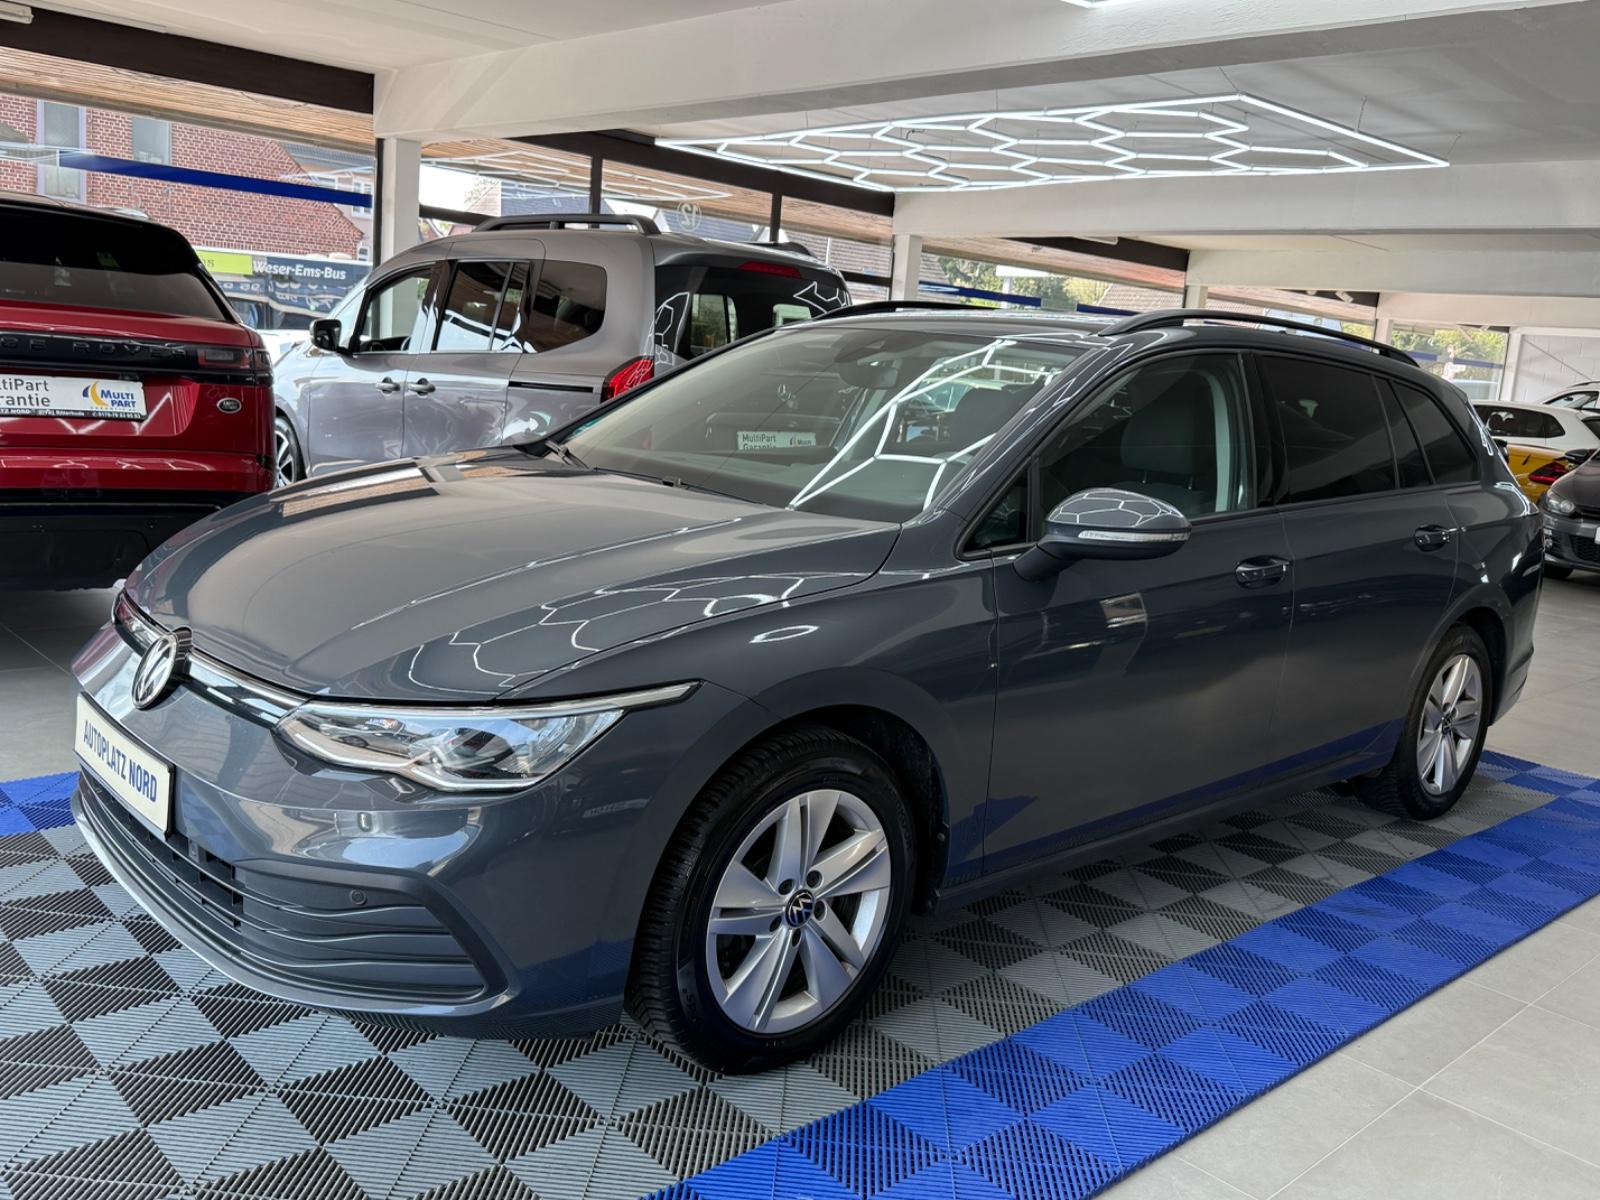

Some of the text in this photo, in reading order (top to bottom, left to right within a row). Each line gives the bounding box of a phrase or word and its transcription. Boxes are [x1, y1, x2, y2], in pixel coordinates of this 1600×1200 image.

[253, 260, 347, 280] Weser-Ems-Bus
[73, 341, 187, 360] ROVER
[0, 377, 49, 391] tiPart
[101, 389, 134, 400] MULTI
[111, 400, 137, 408] PART
[742, 433, 777, 442] MultiPart
[83, 719, 158, 802] AUTOPLATZ NORD
